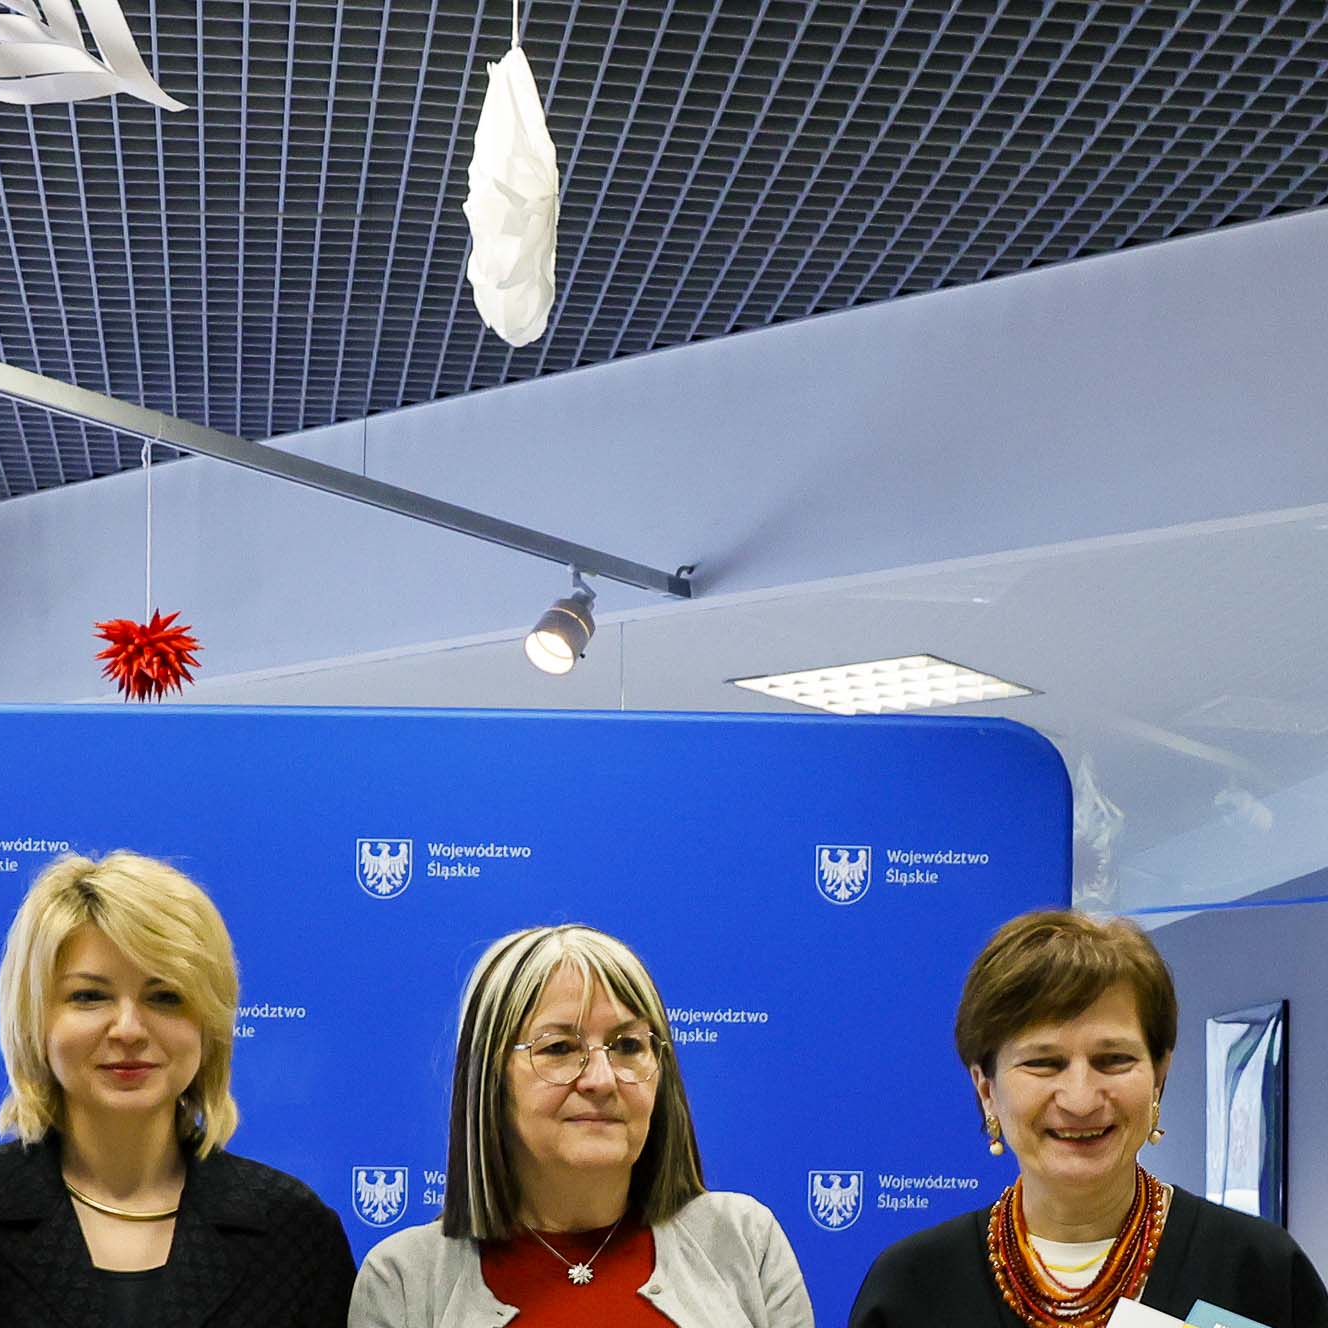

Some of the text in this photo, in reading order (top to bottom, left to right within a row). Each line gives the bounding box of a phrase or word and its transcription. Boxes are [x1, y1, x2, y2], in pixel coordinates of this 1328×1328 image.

[428, 842, 531, 859] Województwo
[886, 849, 989, 866] Województwo
[426, 860, 481, 881] Śląskie
[886, 866, 939, 887] Śląskie
[666, 1008, 768, 1025] Województwo
[671, 1028, 718, 1045] ląskie
[878, 1173, 978, 1191] Województwo
[877, 1191, 930, 1210] Śląskie
